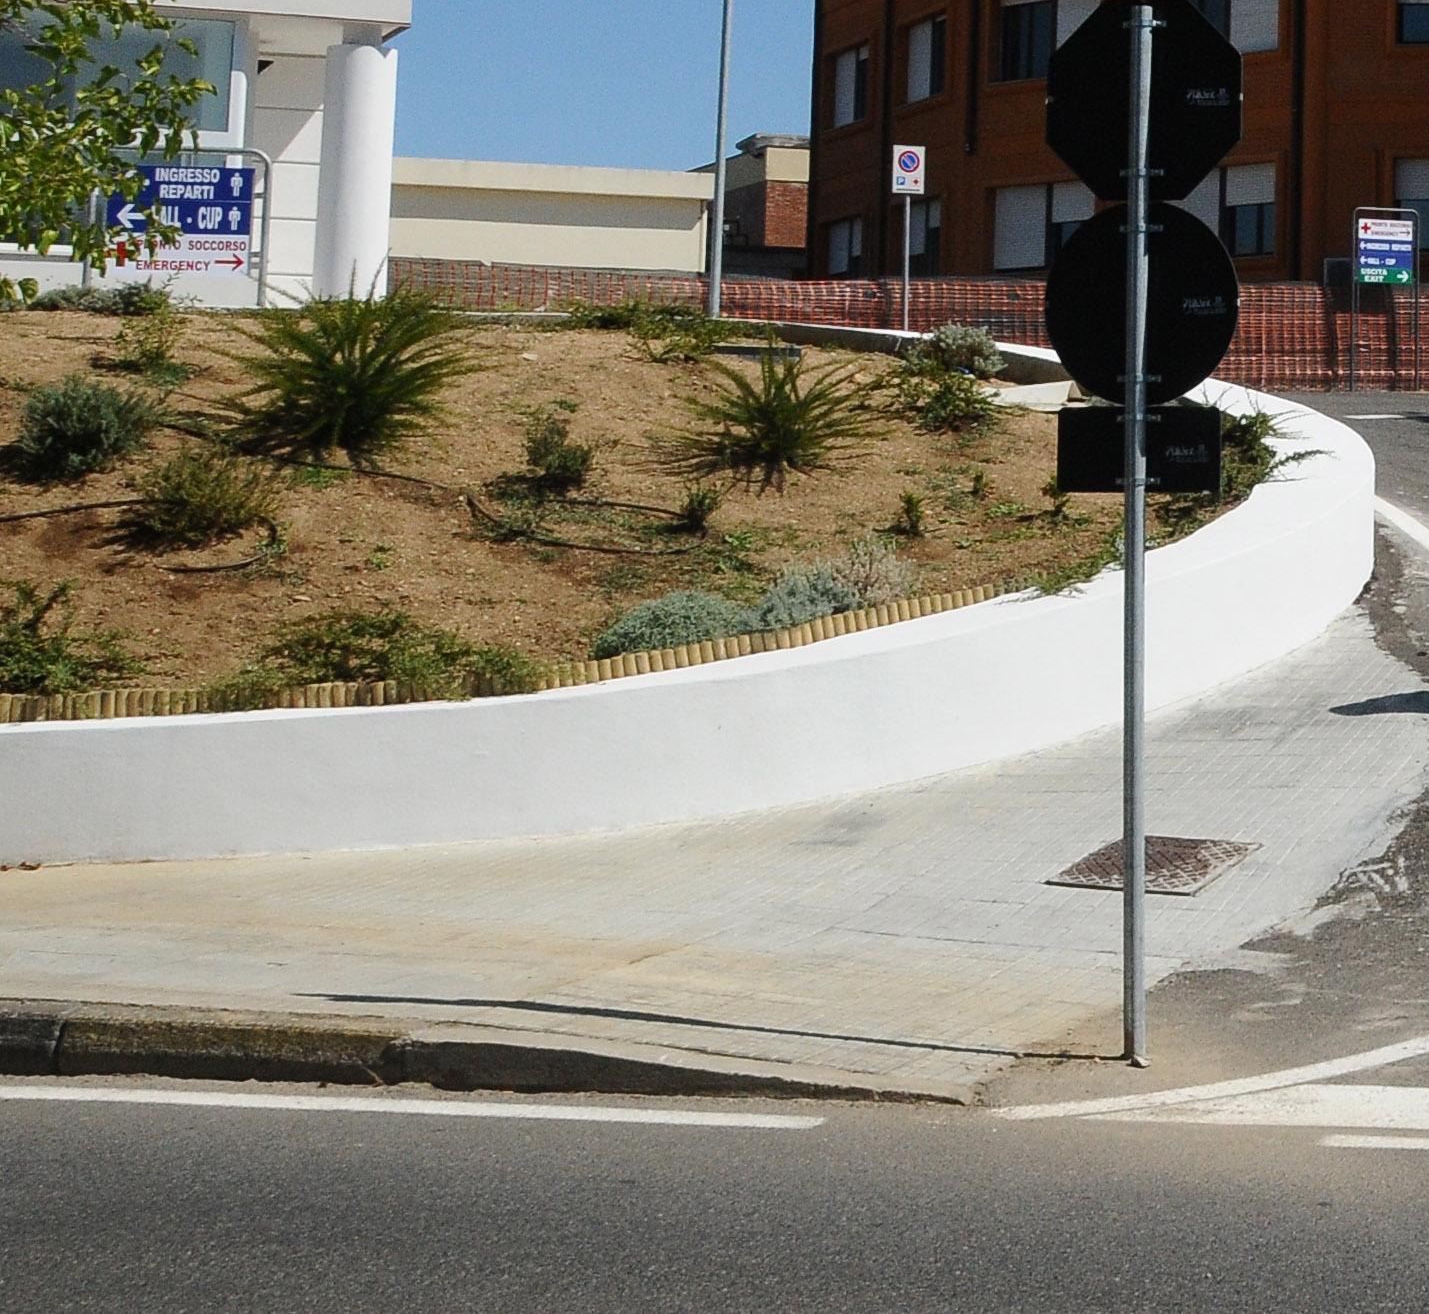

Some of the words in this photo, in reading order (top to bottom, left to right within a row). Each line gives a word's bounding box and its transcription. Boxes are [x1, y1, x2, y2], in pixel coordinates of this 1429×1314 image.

[155, 168, 220, 183] INGRESSO
[159, 185, 215, 199] REPARTI
[198, 206, 223, 230] CUP
[188, 240, 247, 251] SOCCORSO
[136, 260, 211, 271] EMERGENCY
[1360, 268, 1388, 276] USCITA
